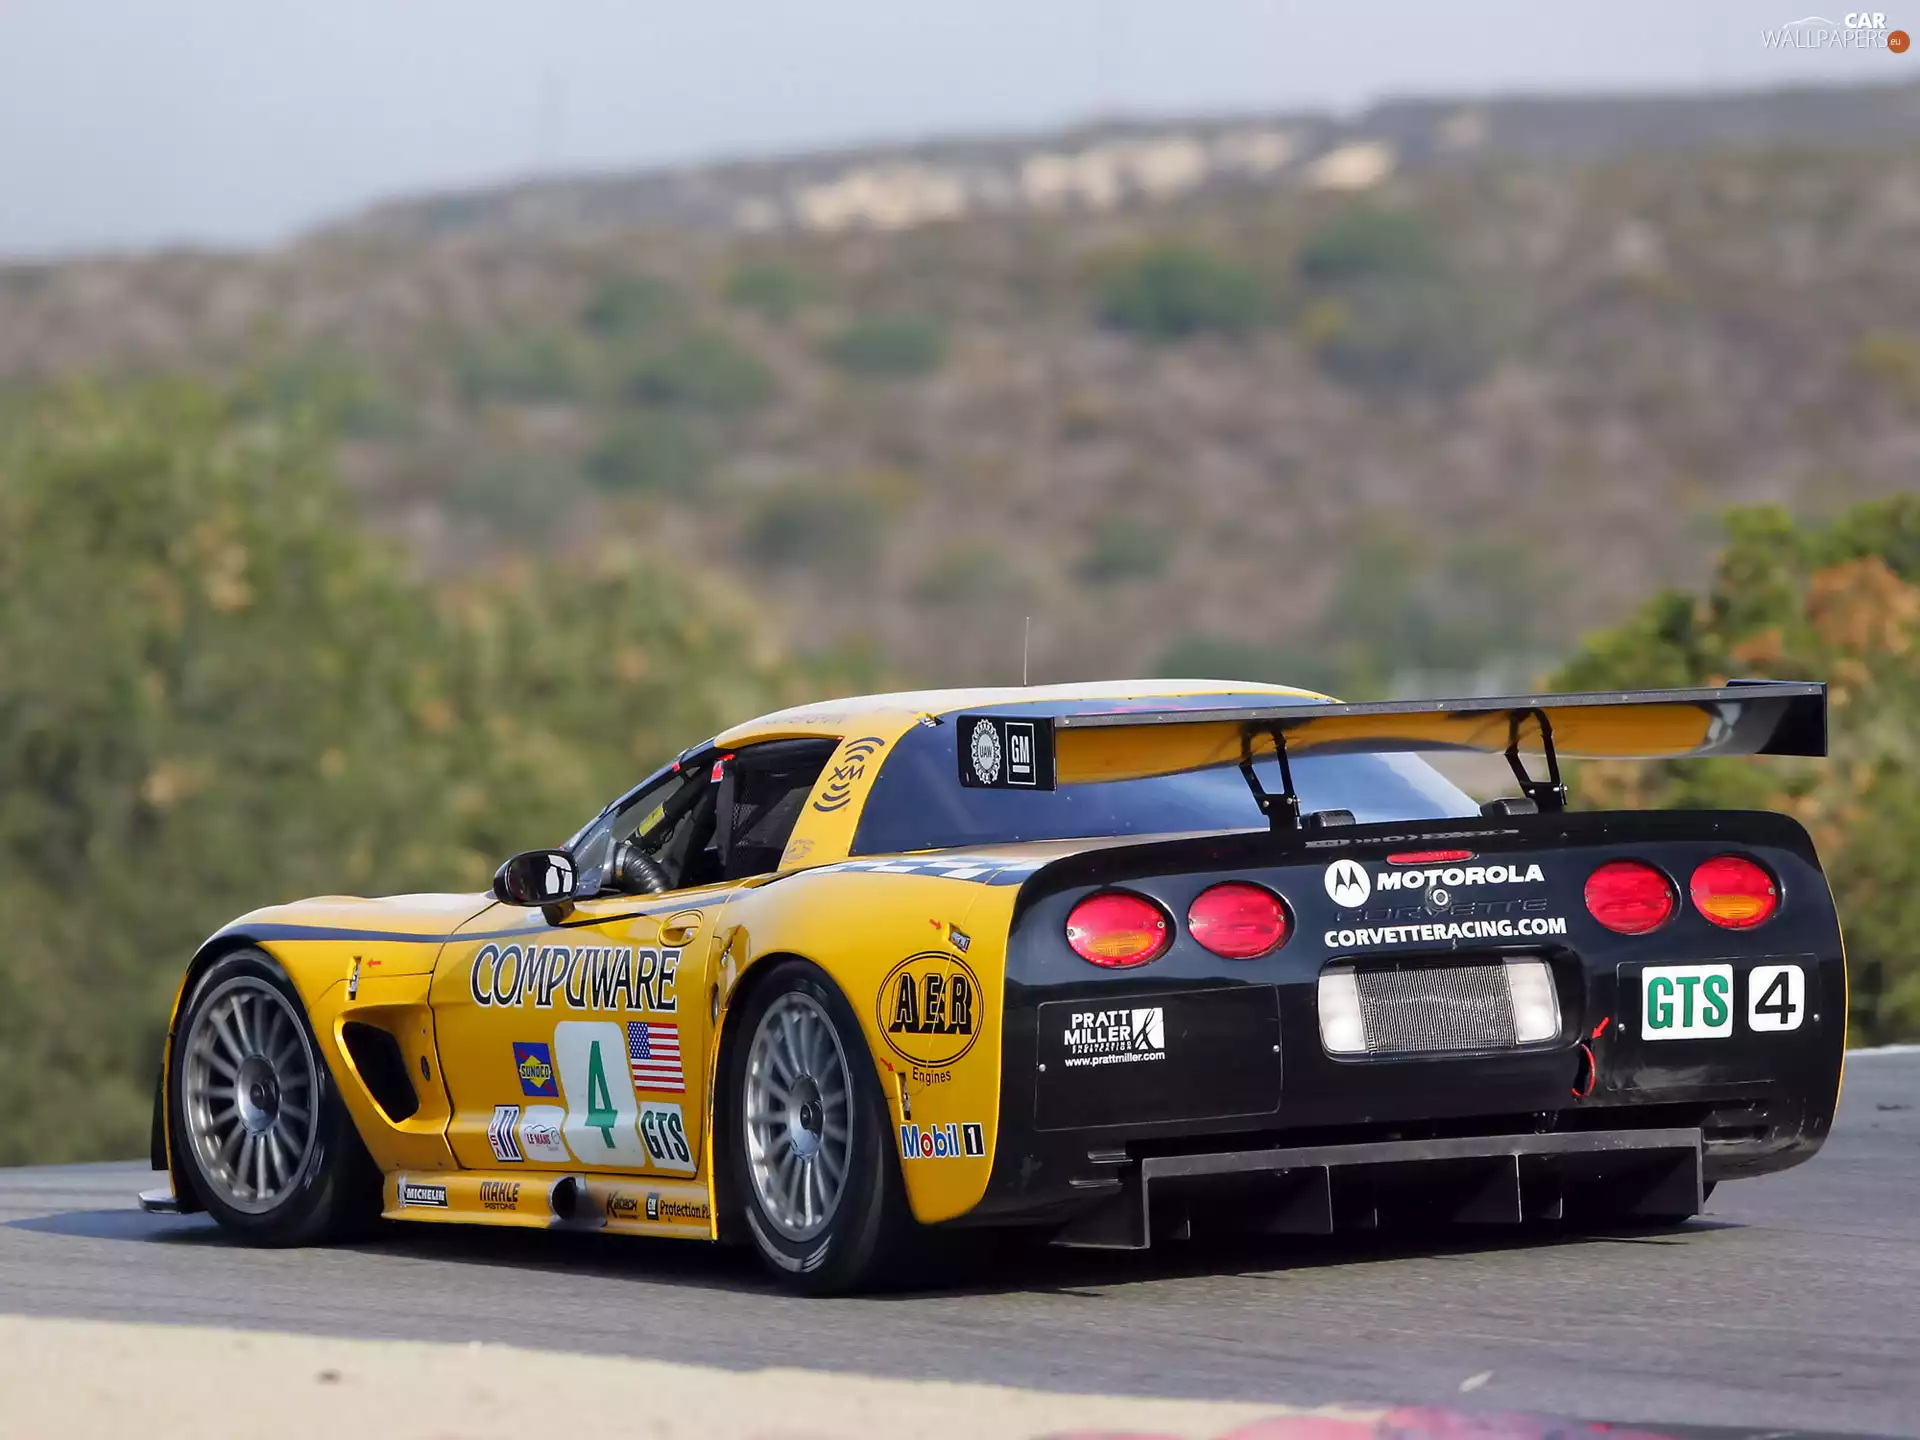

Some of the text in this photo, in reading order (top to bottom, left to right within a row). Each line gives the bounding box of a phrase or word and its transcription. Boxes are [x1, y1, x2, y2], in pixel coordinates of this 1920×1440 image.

[1011, 734, 1030, 764] GM
[828, 764, 865, 781] XM
[1376, 864, 1545, 891] MOTOROLA
[1324, 917, 1567, 948] CORVETTERACING.COM
[470, 943, 681, 1013] COMPUWARE
[888, 972, 972, 1034] AER
[1647, 975, 1729, 1029] GTS
[1755, 971, 1796, 1024] 4
[1071, 1010, 1130, 1029] PRATT
[1064, 1026, 1131, 1045] MILLER
[1065, 1052, 1165, 1067] www.prattmiller.com
[520, 1064, 551, 1078] SUNOCO
[912, 1066, 952, 1087] Engines
[585, 1040, 618, 1149] 4
[526, 1133, 535, 1144] LE
[640, 1109, 689, 1163] GTS
[900, 1124, 960, 1159] Mobil
[406, 1187, 445, 1201] MICHELIN
[480, 1181, 521, 1202] MAHLE
[484, 1202, 516, 1210] PISTONS
[659, 1200, 701, 1217] Protection
